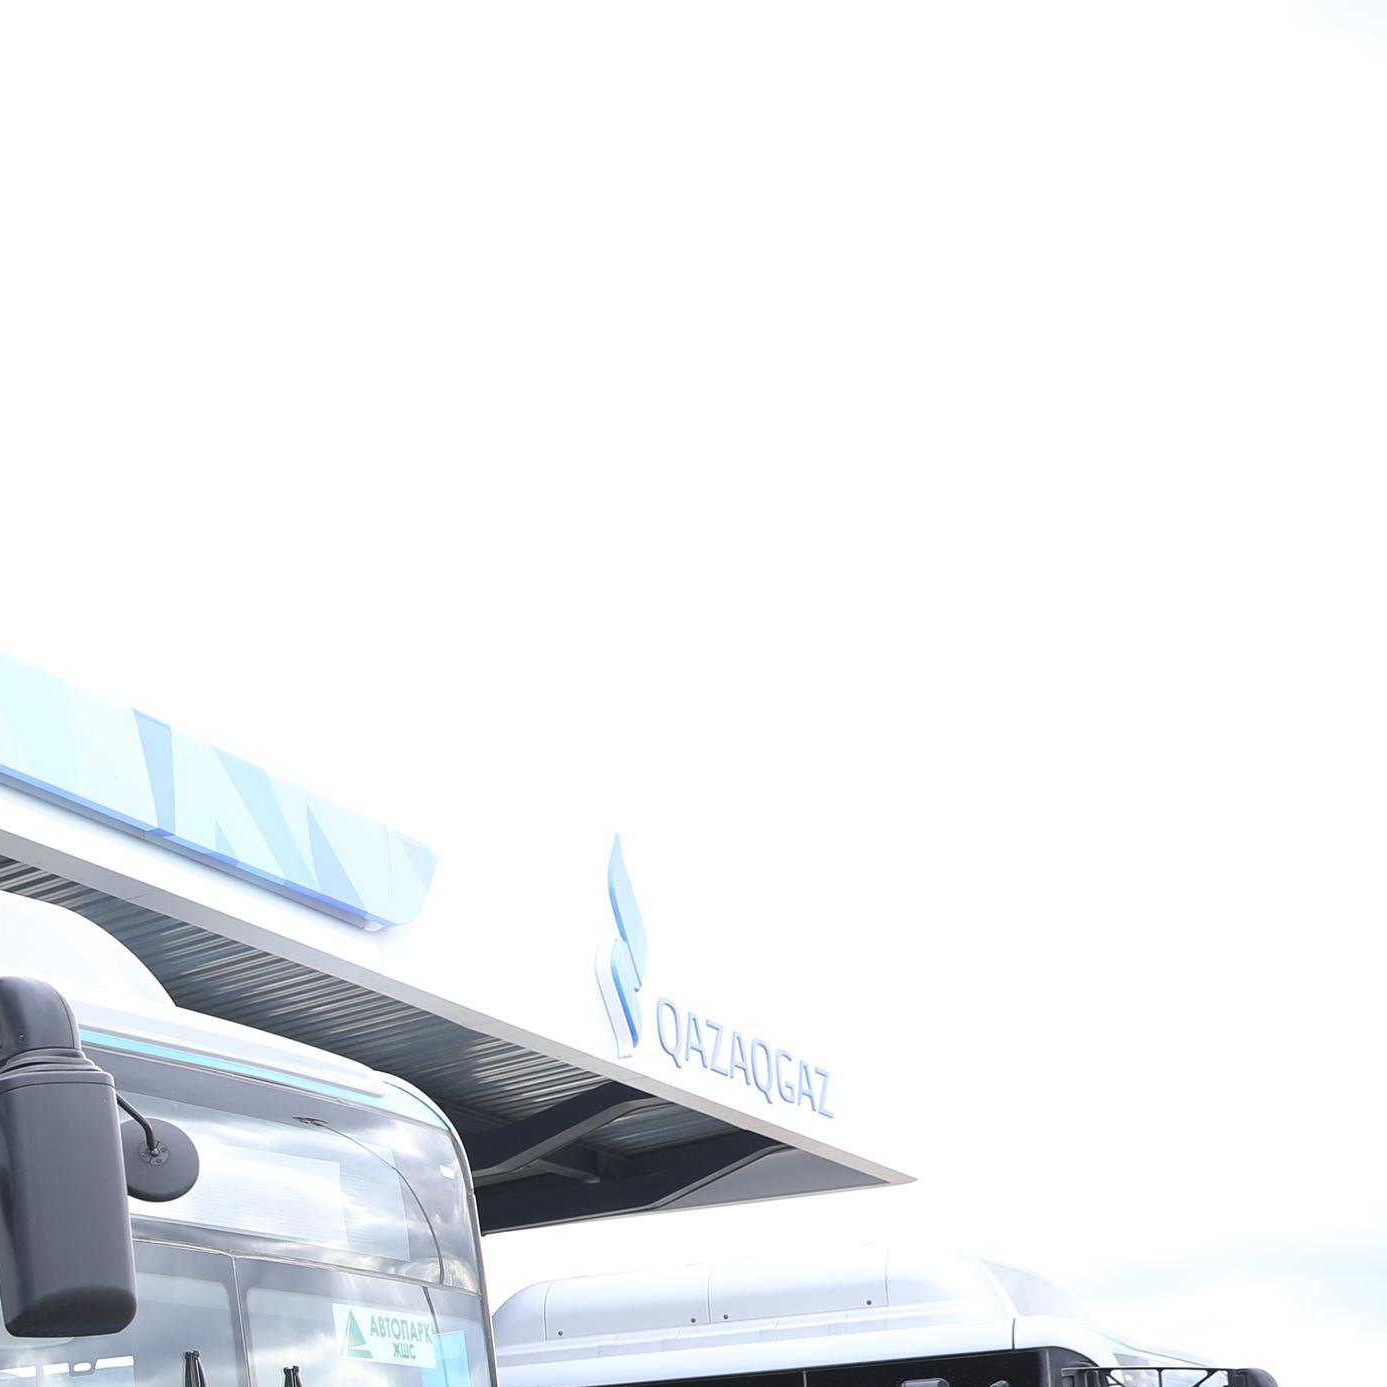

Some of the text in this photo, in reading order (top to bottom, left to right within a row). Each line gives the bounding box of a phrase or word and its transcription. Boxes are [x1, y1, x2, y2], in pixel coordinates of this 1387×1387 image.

[656, 996, 835, 1119] QAZAQGAZ
[371, 1316, 432, 1344] АВТОПАРК
[393, 1343, 416, 1360] ЖШС
